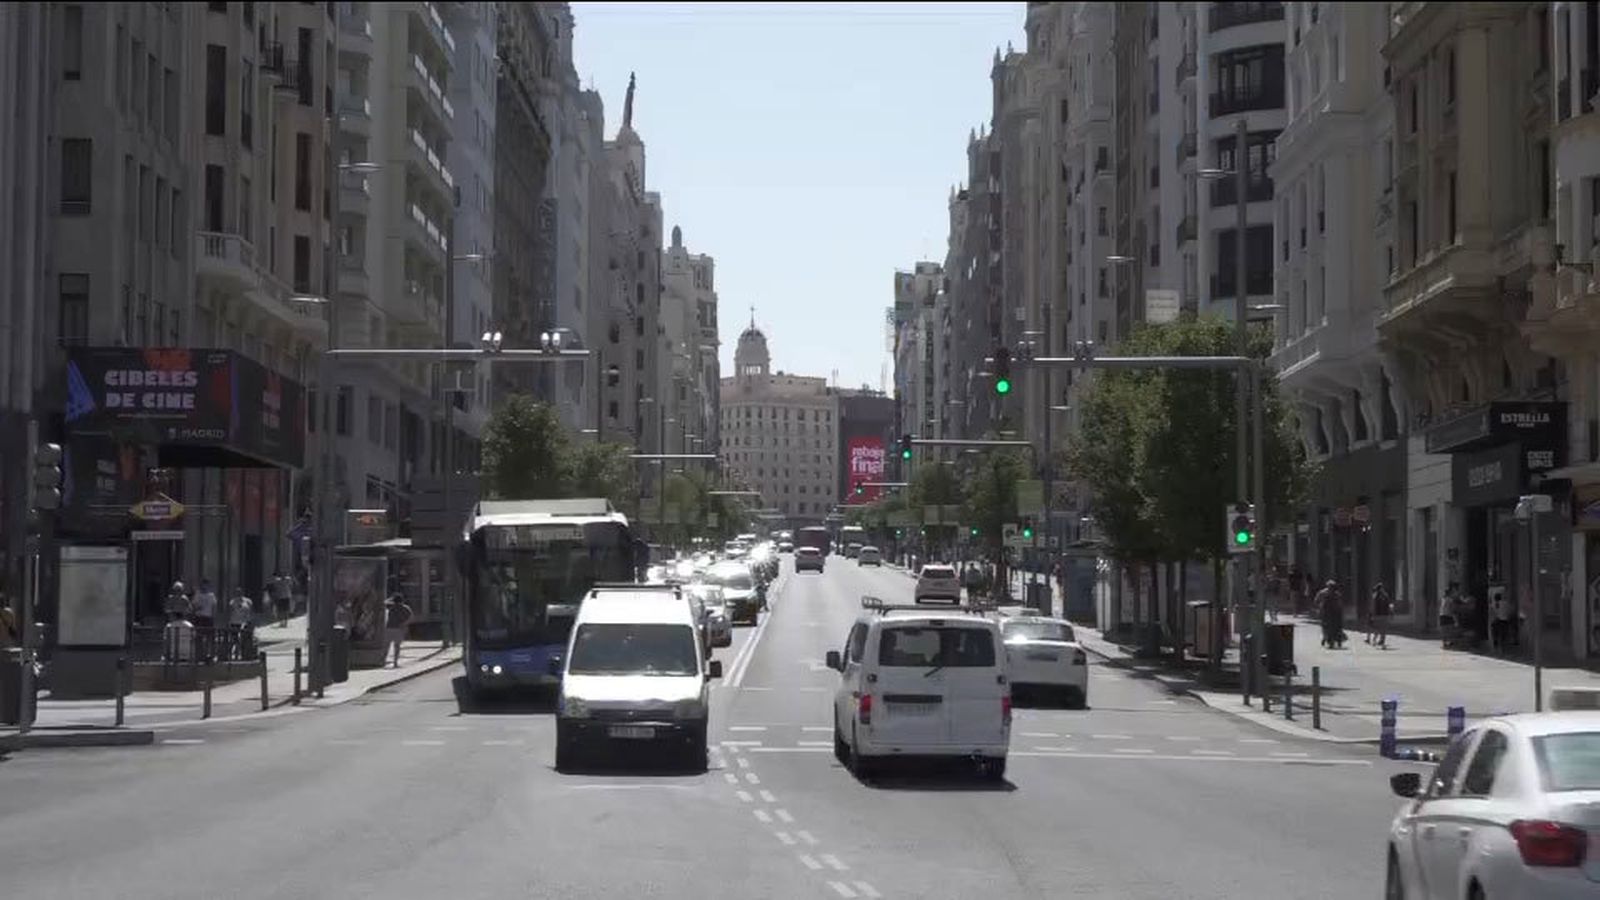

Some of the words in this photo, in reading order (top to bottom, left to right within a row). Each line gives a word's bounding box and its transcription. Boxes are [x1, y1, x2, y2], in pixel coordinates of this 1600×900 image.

[104, 369, 199, 387] CIBELES
[105, 393, 136, 408] DE
[142, 393, 196, 409] CINE
[1501, 413, 1550, 423] ESTRELLA
[852, 457, 884, 474] final
